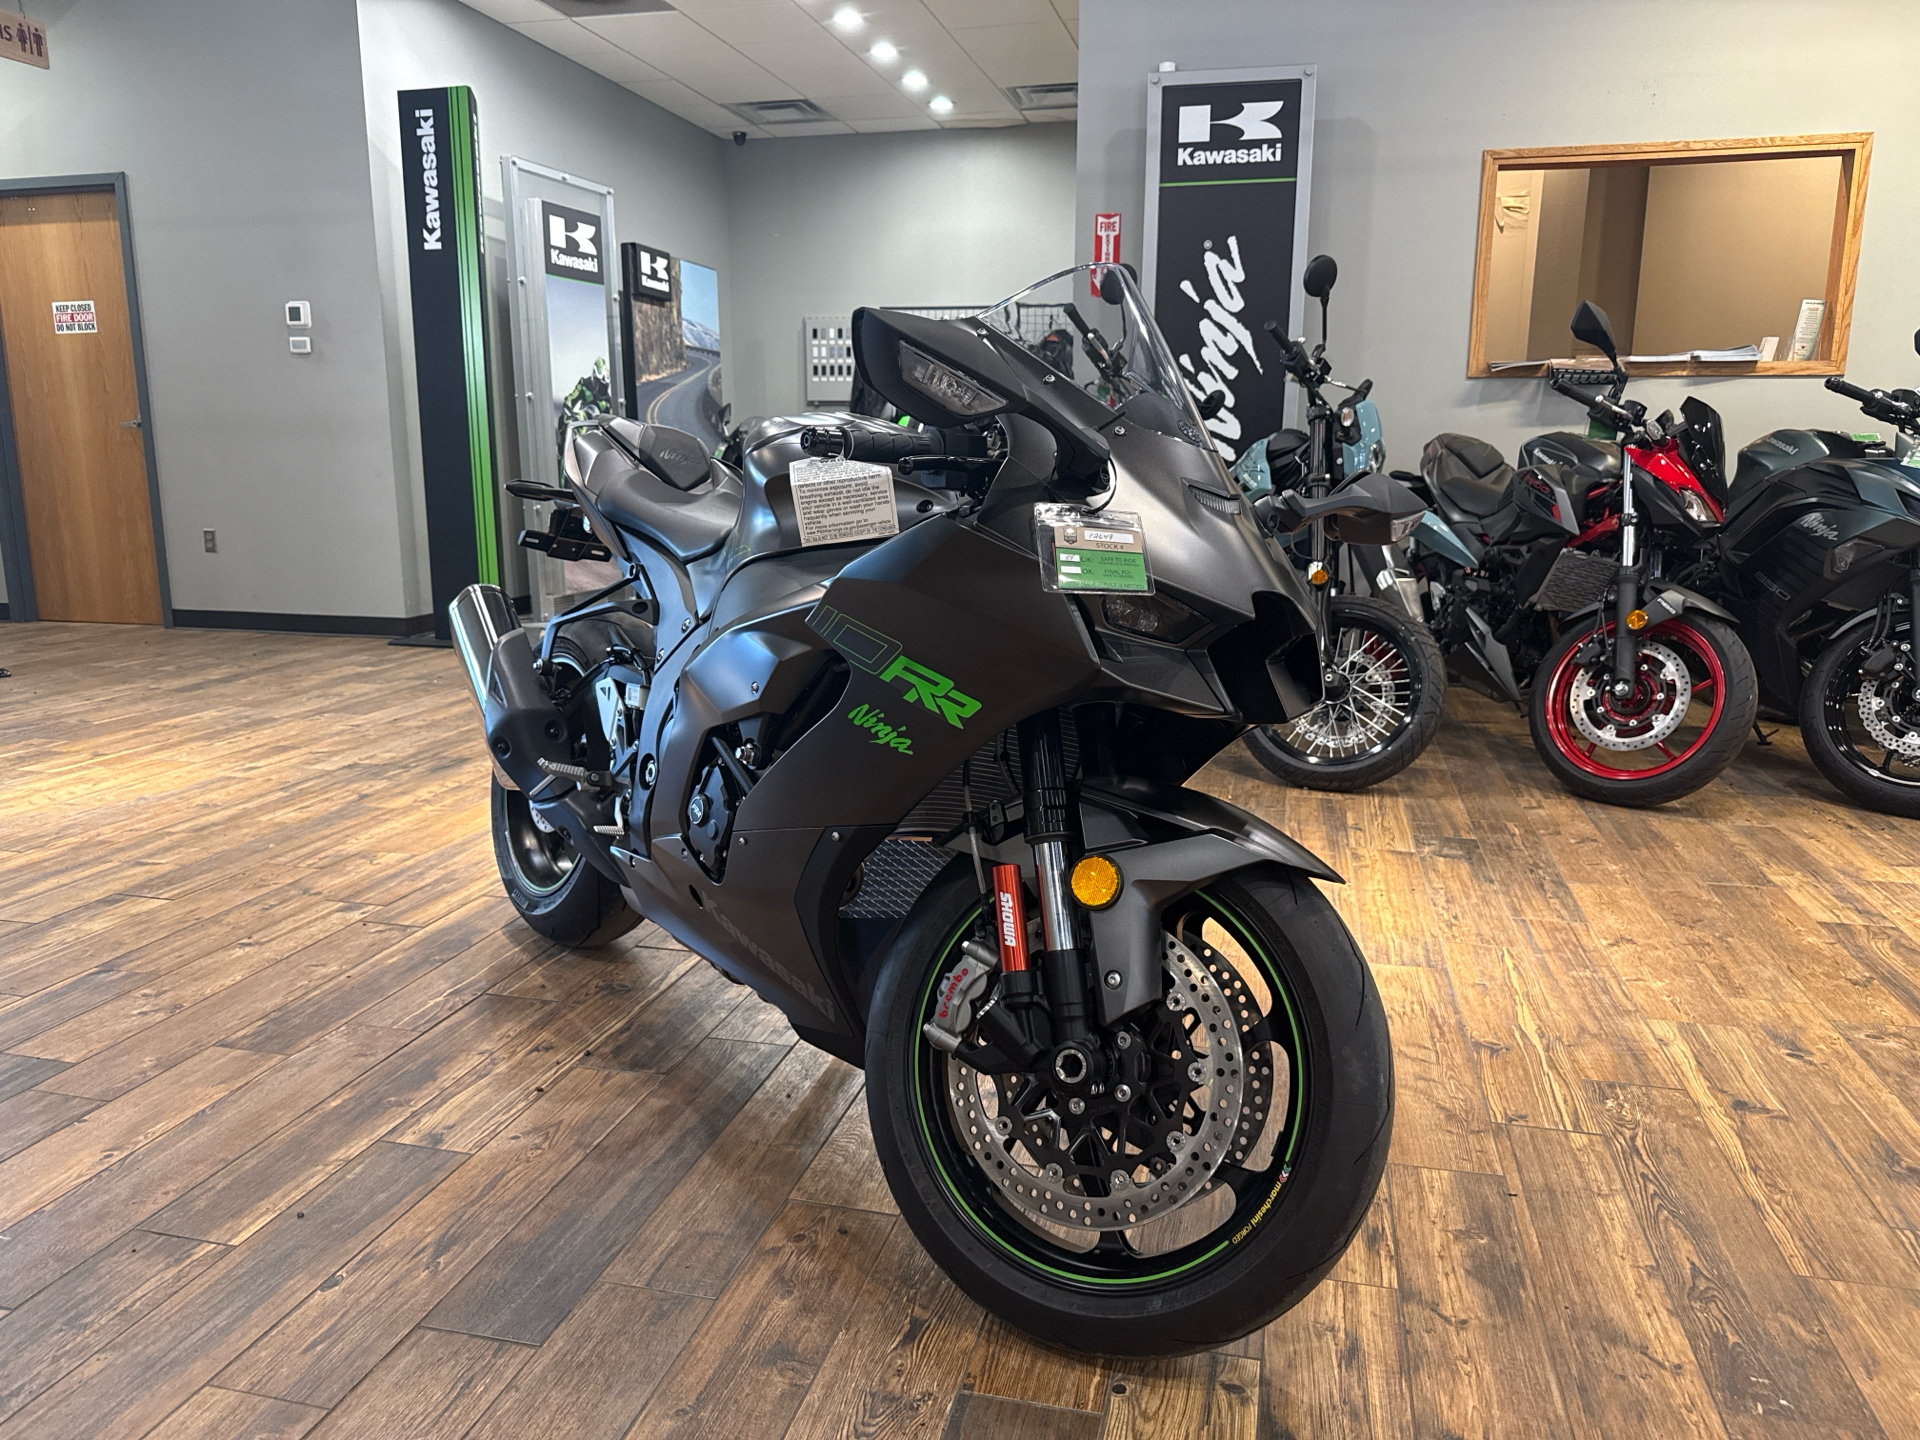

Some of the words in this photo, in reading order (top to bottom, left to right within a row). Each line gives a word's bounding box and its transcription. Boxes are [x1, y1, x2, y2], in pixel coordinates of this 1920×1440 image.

[1177, 143, 1282, 166] Kawasaki
[415, 108, 442, 250] Kawasaki
[1100, 221, 1117, 233] FIRE
[550, 248, 599, 273] Kawasaki
[56, 314, 72, 322] FIRE
[73, 313, 94, 322] DOOR
[70, 304, 91, 312] CLOSED
[56, 324, 64, 332] DO
[65, 323, 76, 331] NOT
[77, 323, 96, 331] BLOCK
[1800, 513, 1838, 541] Ninja
[1095, 542, 1119, 550] STOCK
[1754, 570, 1791, 601] 650
[1656, 597, 1677, 615] ABS
[847, 703, 914, 756] Ninja
[1000, 891, 1017, 948] SHOWA
[701, 889, 836, 1024] Kawasaki
[938, 967, 969, 1020] brembo
[1250, 1181, 1282, 1227] marchesini
[1231, 1222, 1253, 1244] FORGED
